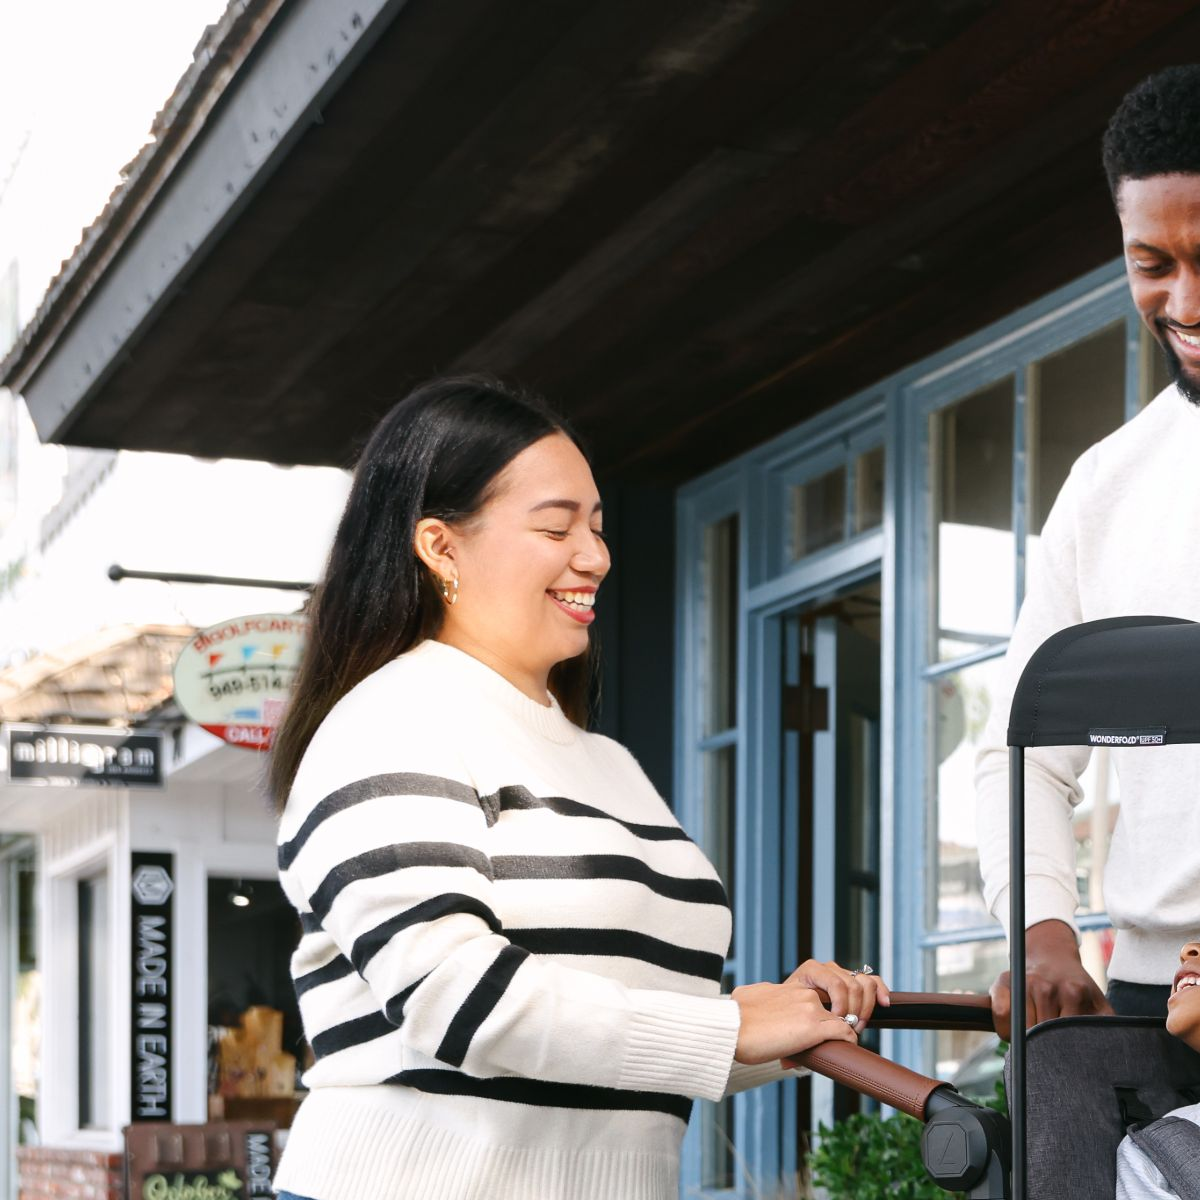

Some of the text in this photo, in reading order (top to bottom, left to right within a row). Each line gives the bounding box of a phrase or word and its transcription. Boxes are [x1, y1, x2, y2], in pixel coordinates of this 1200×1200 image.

[136, 915, 167, 1117] MADE IN EARTH
[247, 1133, 271, 1193] MADE
